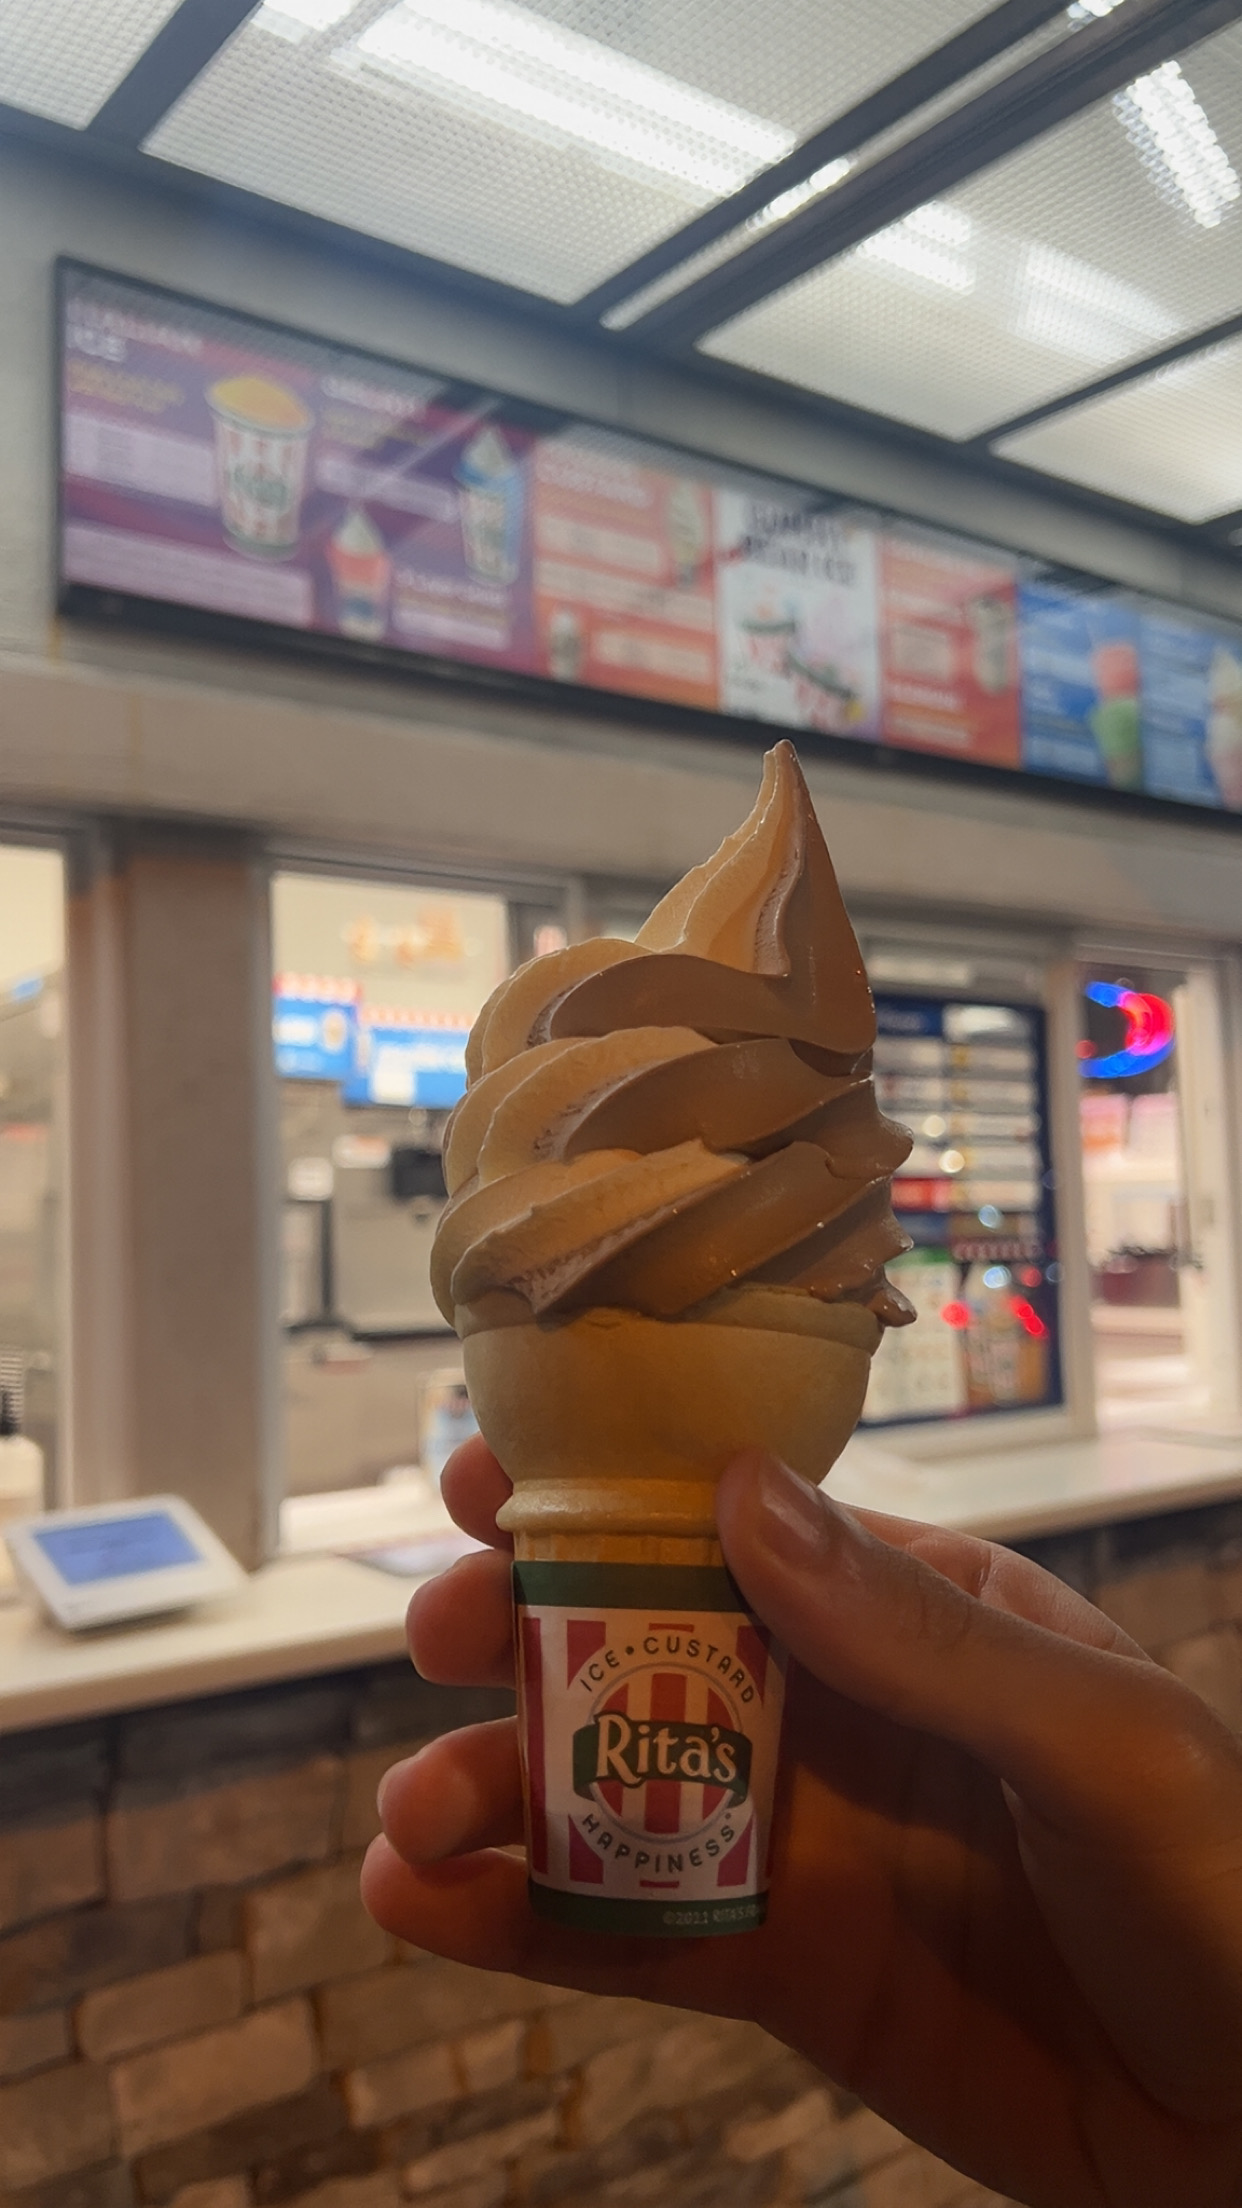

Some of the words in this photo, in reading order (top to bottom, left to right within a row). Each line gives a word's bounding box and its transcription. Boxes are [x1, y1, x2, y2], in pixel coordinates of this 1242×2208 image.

[580, 1650, 620, 1692] ICE
[643, 1636, 756, 1703] CUSTARD
[596, 1714, 737, 1785] Rita's
[582, 1813, 735, 1873] HAPPINESS
